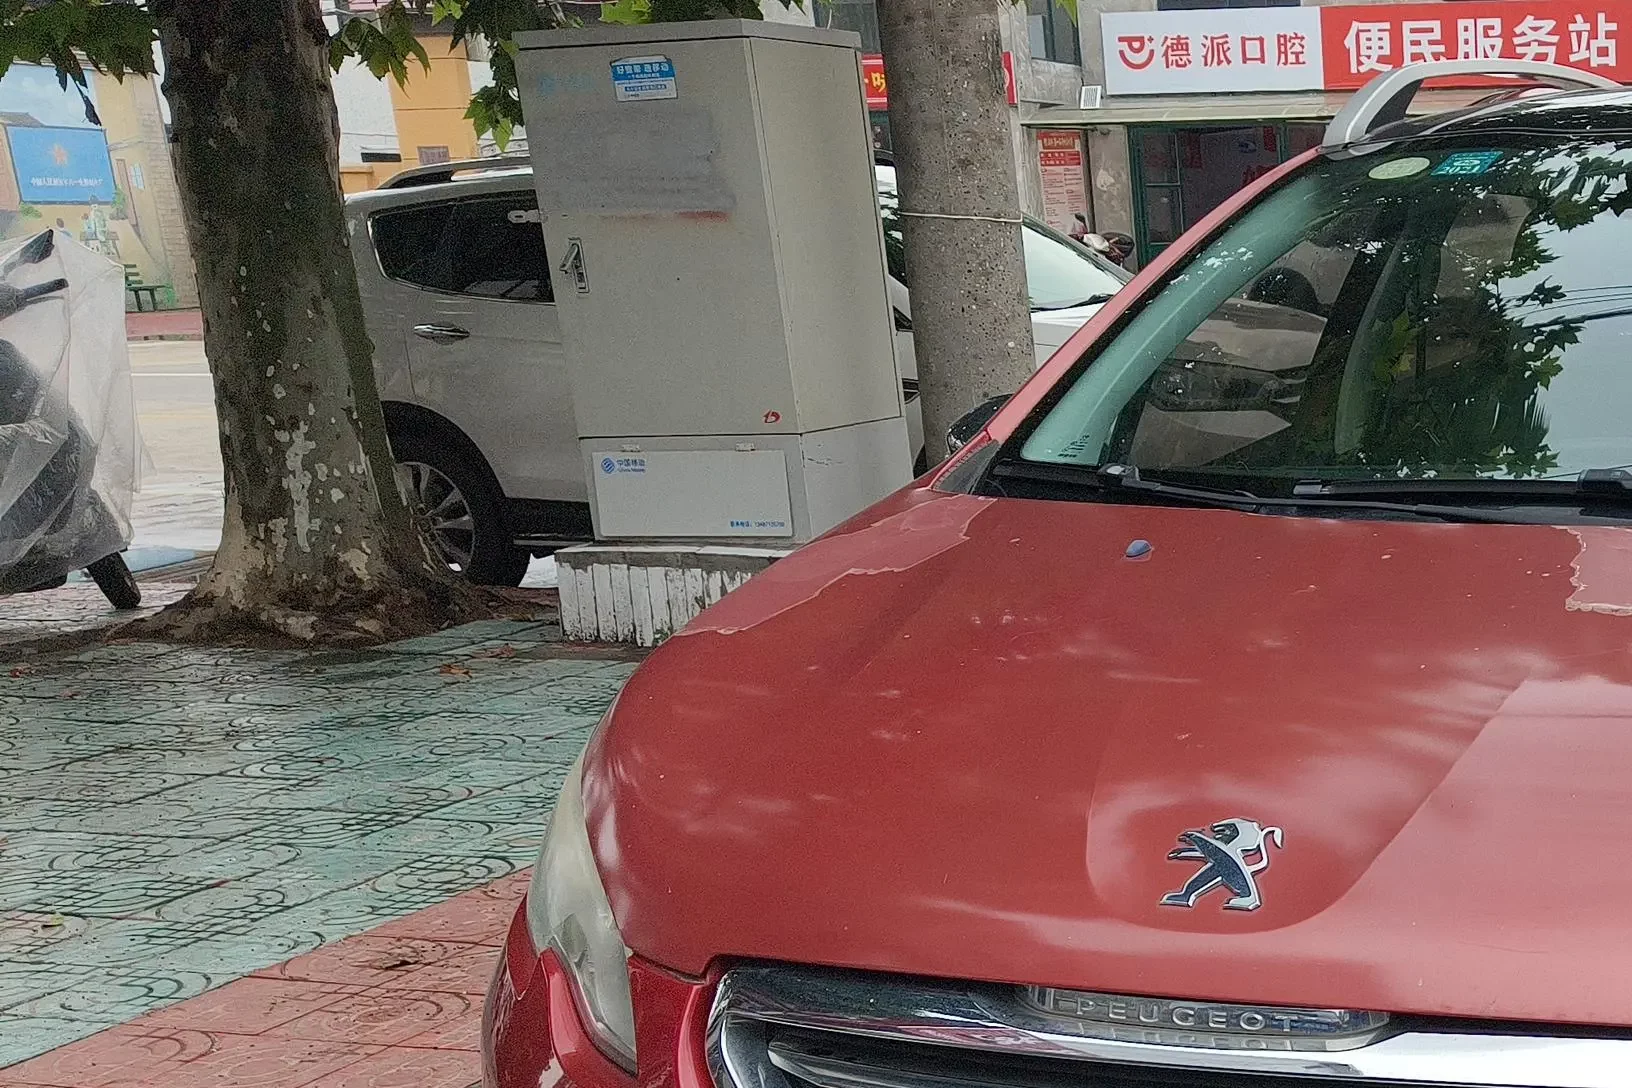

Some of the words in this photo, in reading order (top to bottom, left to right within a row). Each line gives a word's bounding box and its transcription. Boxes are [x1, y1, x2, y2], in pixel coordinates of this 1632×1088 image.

[1161, 32, 1306, 69] 德派口腔
[1344, 12, 1618, 74] 便民服务站
[1077, 1000, 1301, 1032] PEUGEOT
